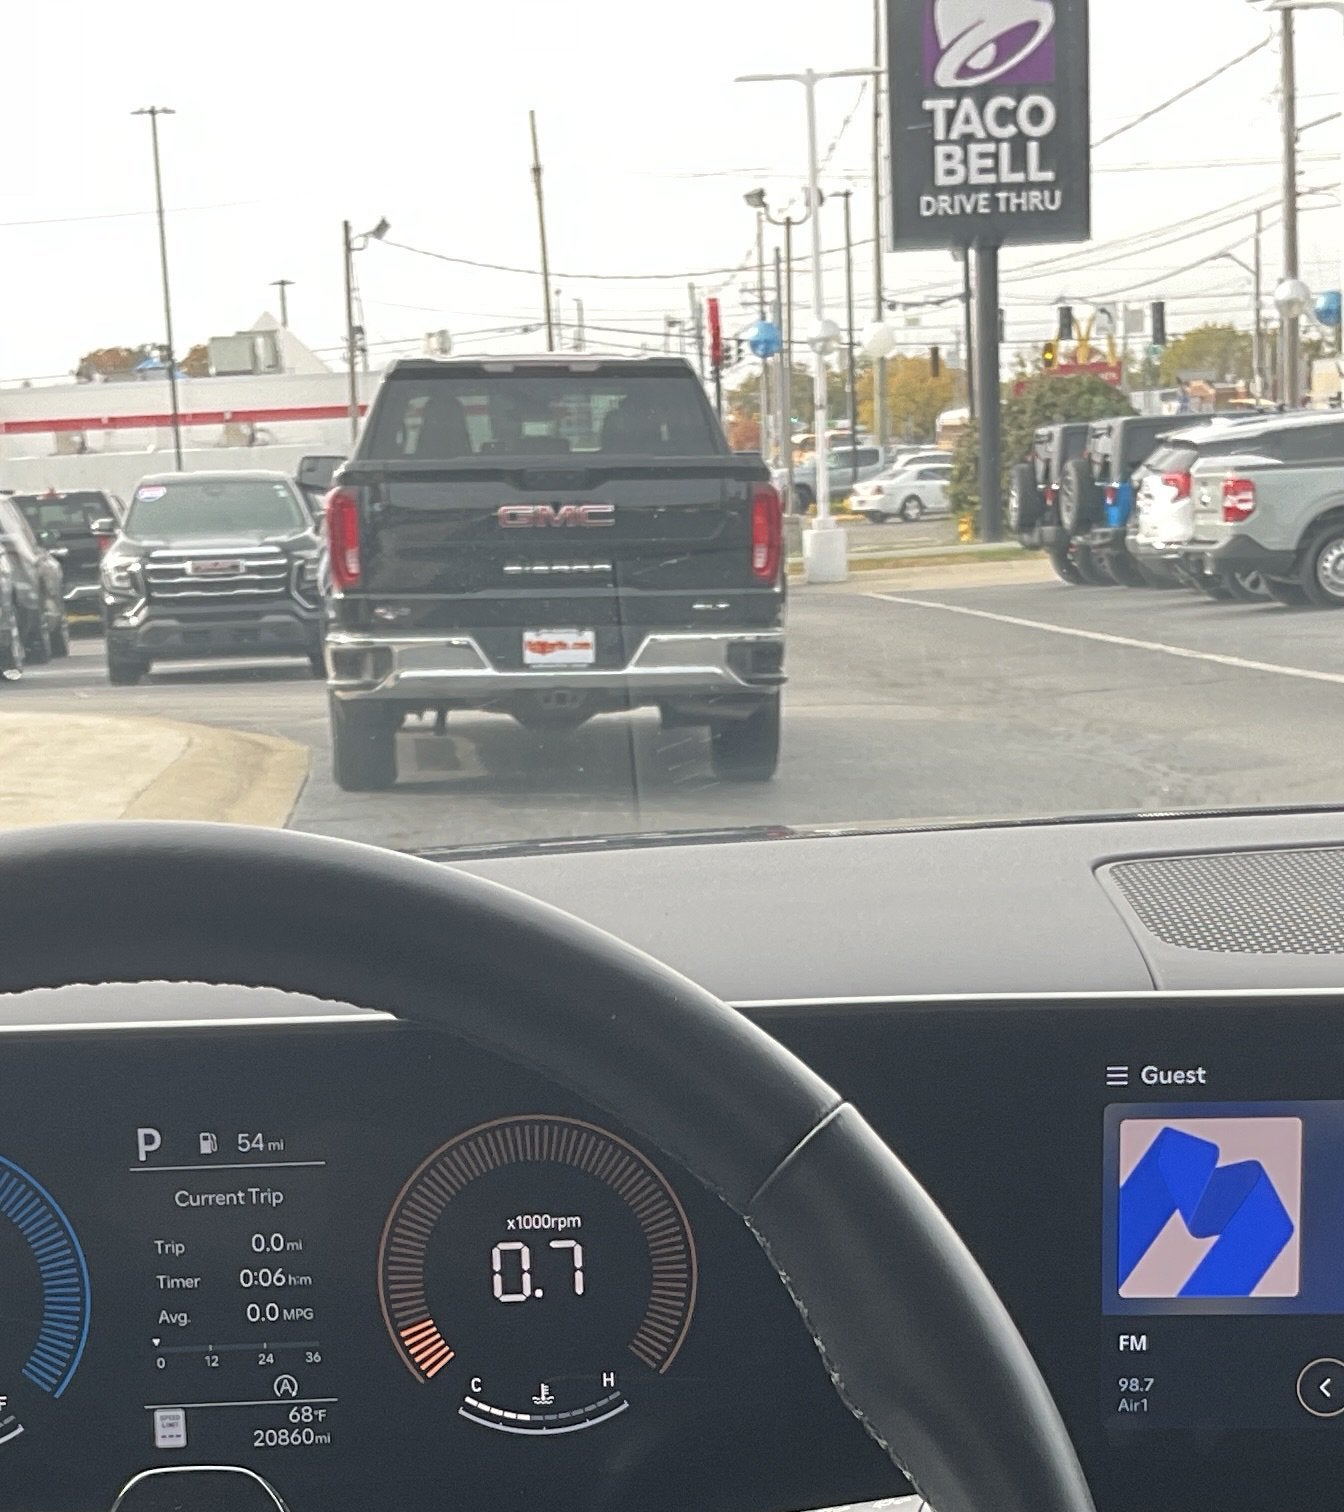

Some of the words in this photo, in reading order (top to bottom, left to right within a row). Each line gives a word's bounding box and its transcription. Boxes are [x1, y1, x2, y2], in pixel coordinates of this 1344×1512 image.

[922, 95, 1056, 141] TACO
[934, 141, 1055, 186] BELL
[920, 193, 990, 216] DRIVE
[995, 190, 1062, 213] THRU
[498, 504, 616, 528] GMC
[1140, 1065, 1207, 1086] Guest
[136, 1128, 162, 1162] P
[237, 1132, 265, 1152] 54
[267, 1139, 285, 1151] mi
[174, 1189, 245, 1207] Current
[248, 1187, 284, 1208] Trip
[506, 1214, 582, 1231] x1000rpm
[154, 1239, 186, 1257] Trip
[491, 1238, 585, 1303] 0.7
[156, 1274, 201, 1290] Timer
[159, 1310, 192, 1327] Avg.
[246, 1302, 279, 1322] 0.0
[283, 1308, 314, 1321] MPG
[1119, 1335, 1147, 1352] FM
[156, 1358, 166, 1369] 0
[204, 1355, 219, 1367] 12
[258, 1353, 275, 1365] 24
[305, 1351, 322, 1363] 36
[470, 1378, 482, 1393] C
[603, 1372, 615, 1387] H
[1118, 1378, 1154, 1393] 98.7
[1118, 1398, 1149, 1413] Air1
